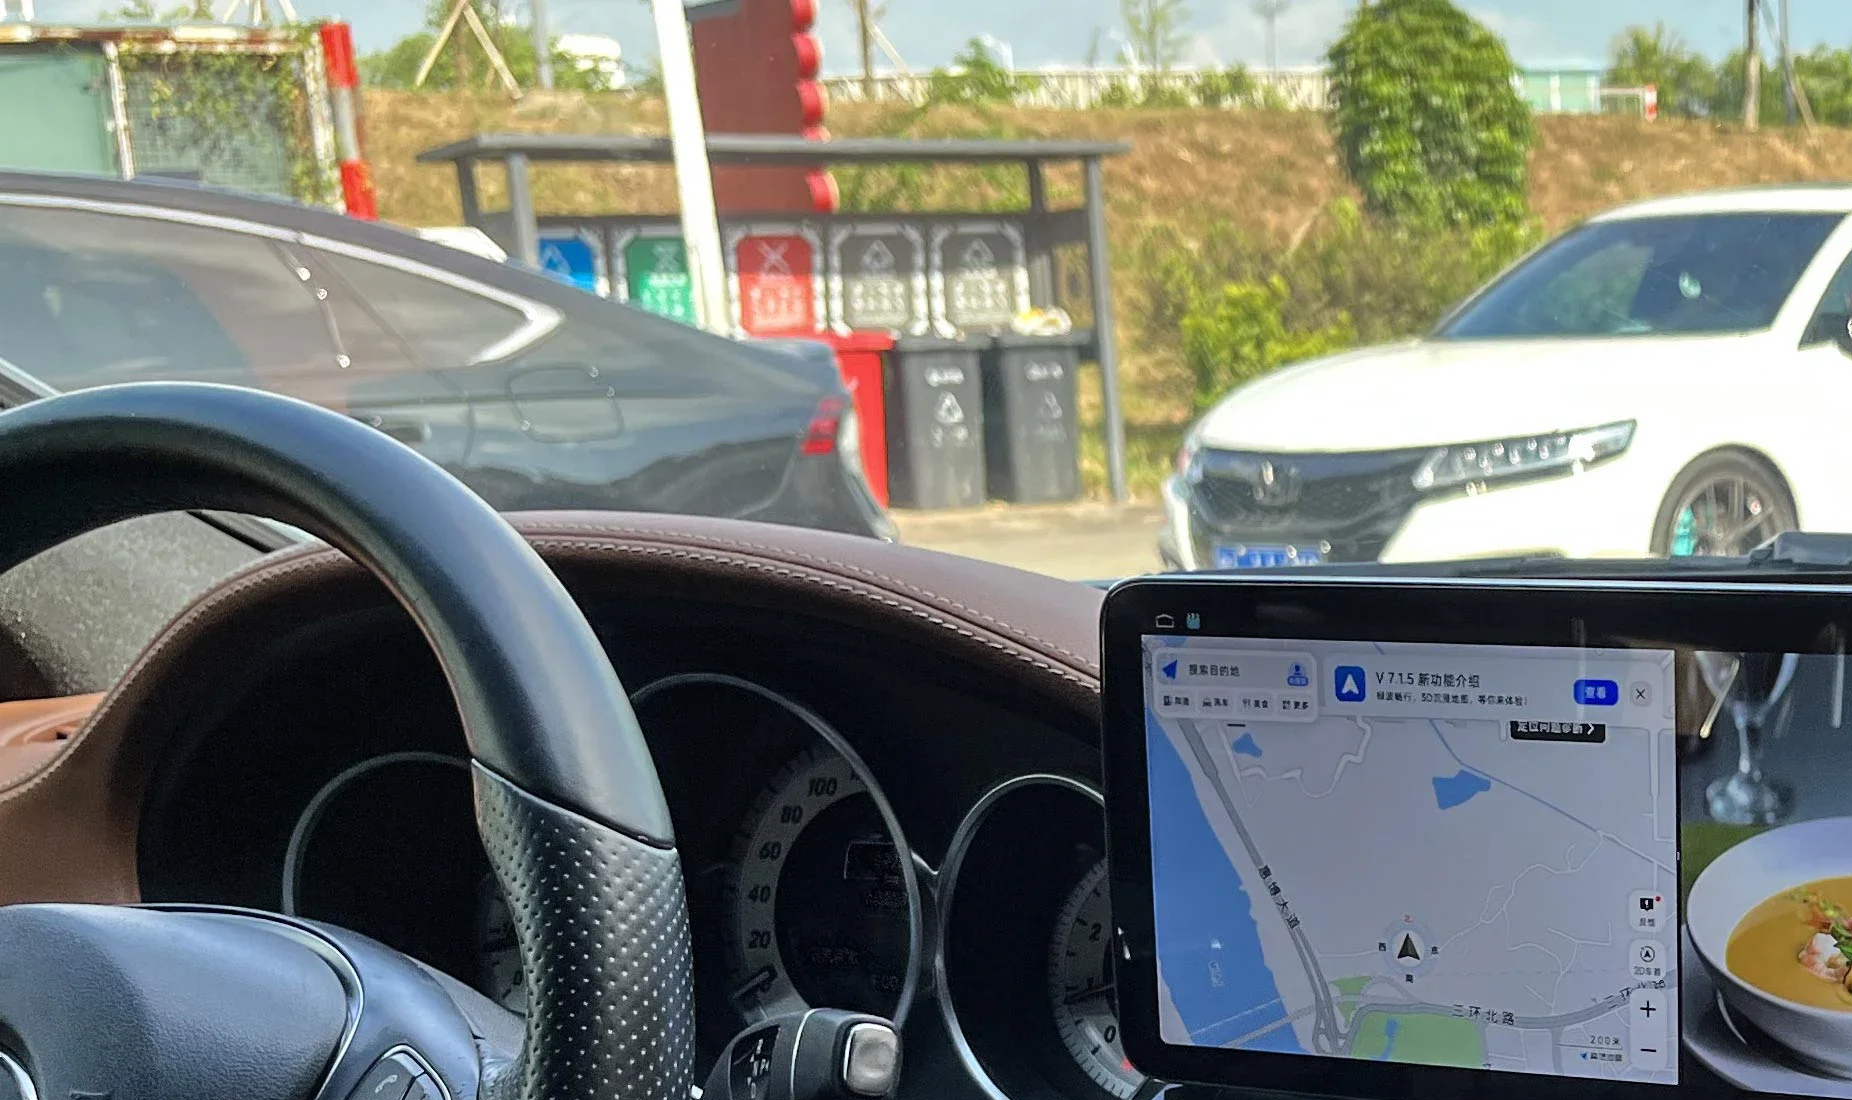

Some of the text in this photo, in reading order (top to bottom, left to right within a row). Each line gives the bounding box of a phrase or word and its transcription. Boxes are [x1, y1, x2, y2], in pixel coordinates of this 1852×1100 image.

[1188, 663, 1241, 678] 搜索目的地
[1388, 672, 1415, 686] 7.1.5
[1417, 673, 1481, 689] 新功能介绍
[807, 777, 838, 798] 100
[781, 806, 804, 825] 80
[758, 843, 781, 862] 60
[748, 885, 771, 902] 40
[748, 930, 771, 950] 20
[1088, 923, 1102, 943] 2
[1451, 1003, 1515, 1026] 三环北路
[1103, 1024, 1117, 1044] 0
